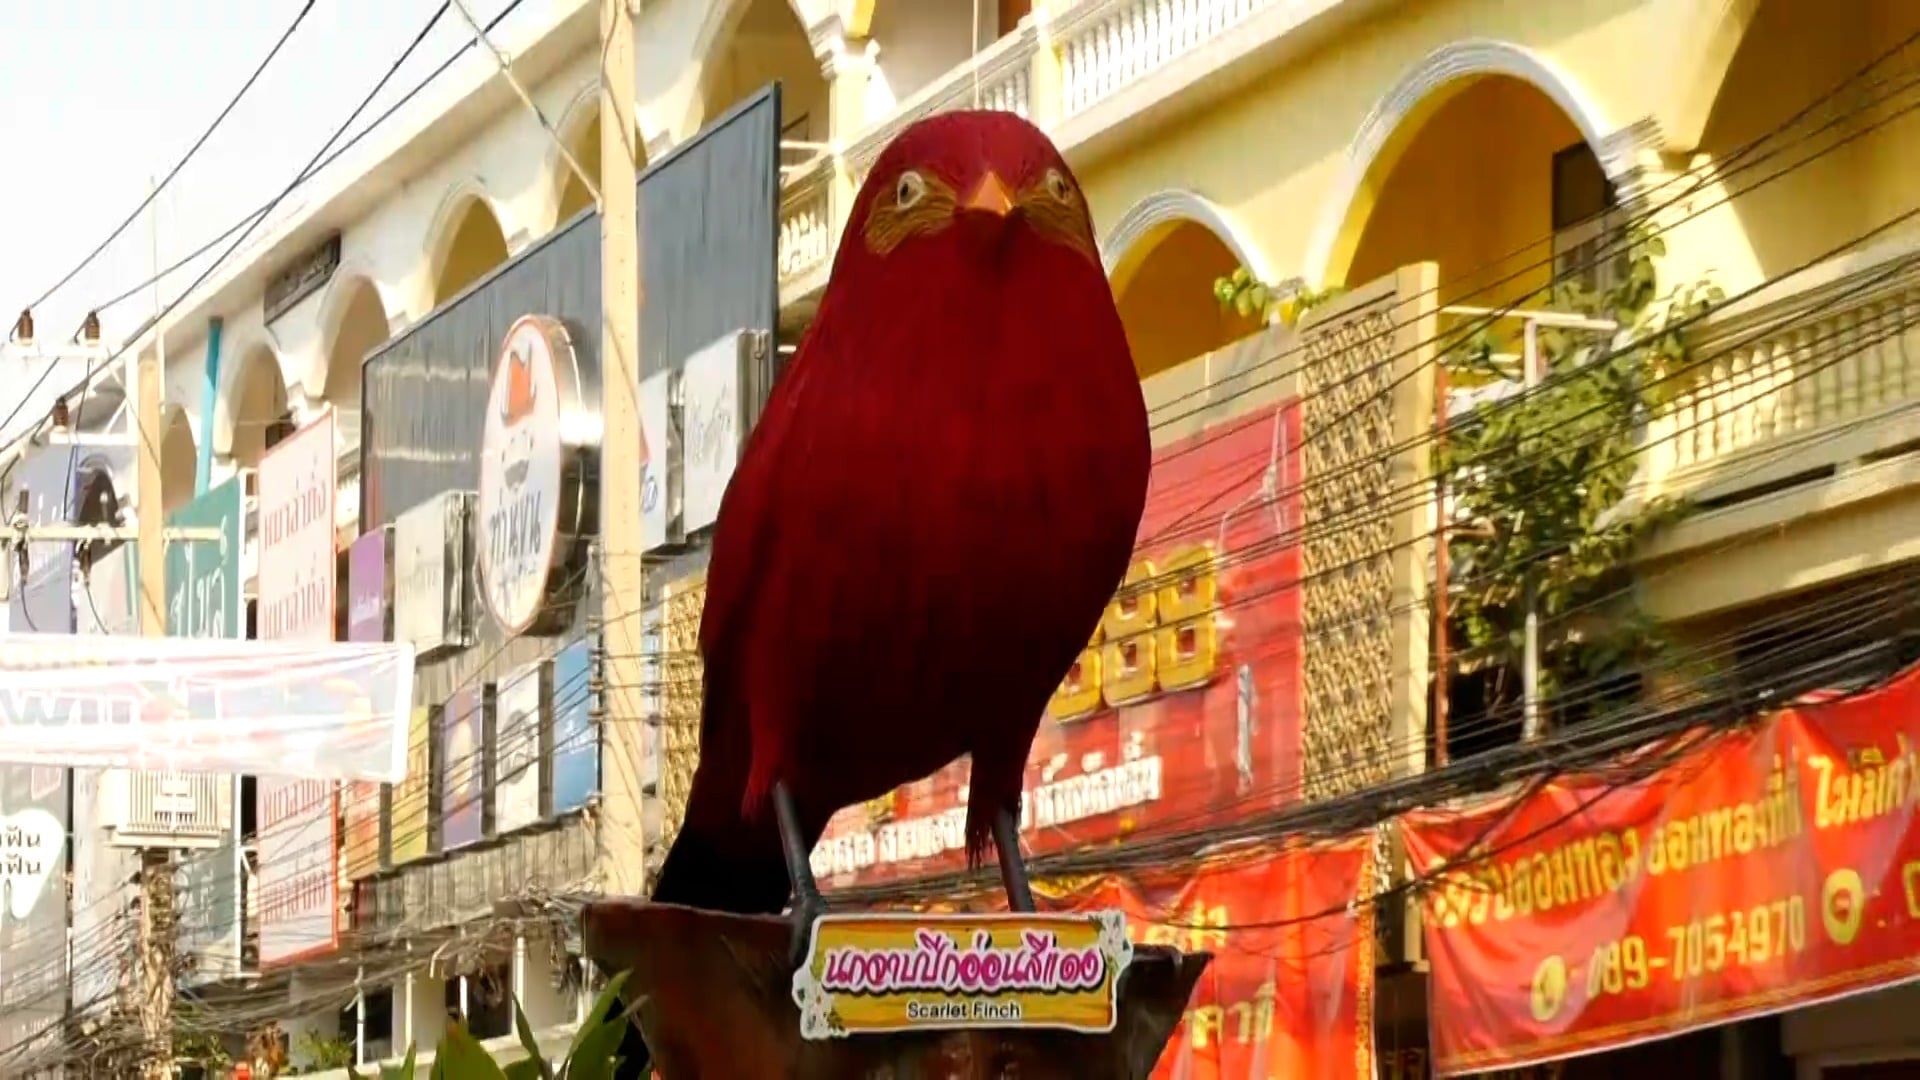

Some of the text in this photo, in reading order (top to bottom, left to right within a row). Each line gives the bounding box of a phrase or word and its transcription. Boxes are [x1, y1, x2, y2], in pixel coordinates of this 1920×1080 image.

[0, 825, 40, 848] ฟัน
[0, 853, 40, 875] ฟัน
[825, 929, 1103, 988] นกจาบปีกอ่อนสีแดง
[907, 1000, 1020, 1019] Scarlet Finch
